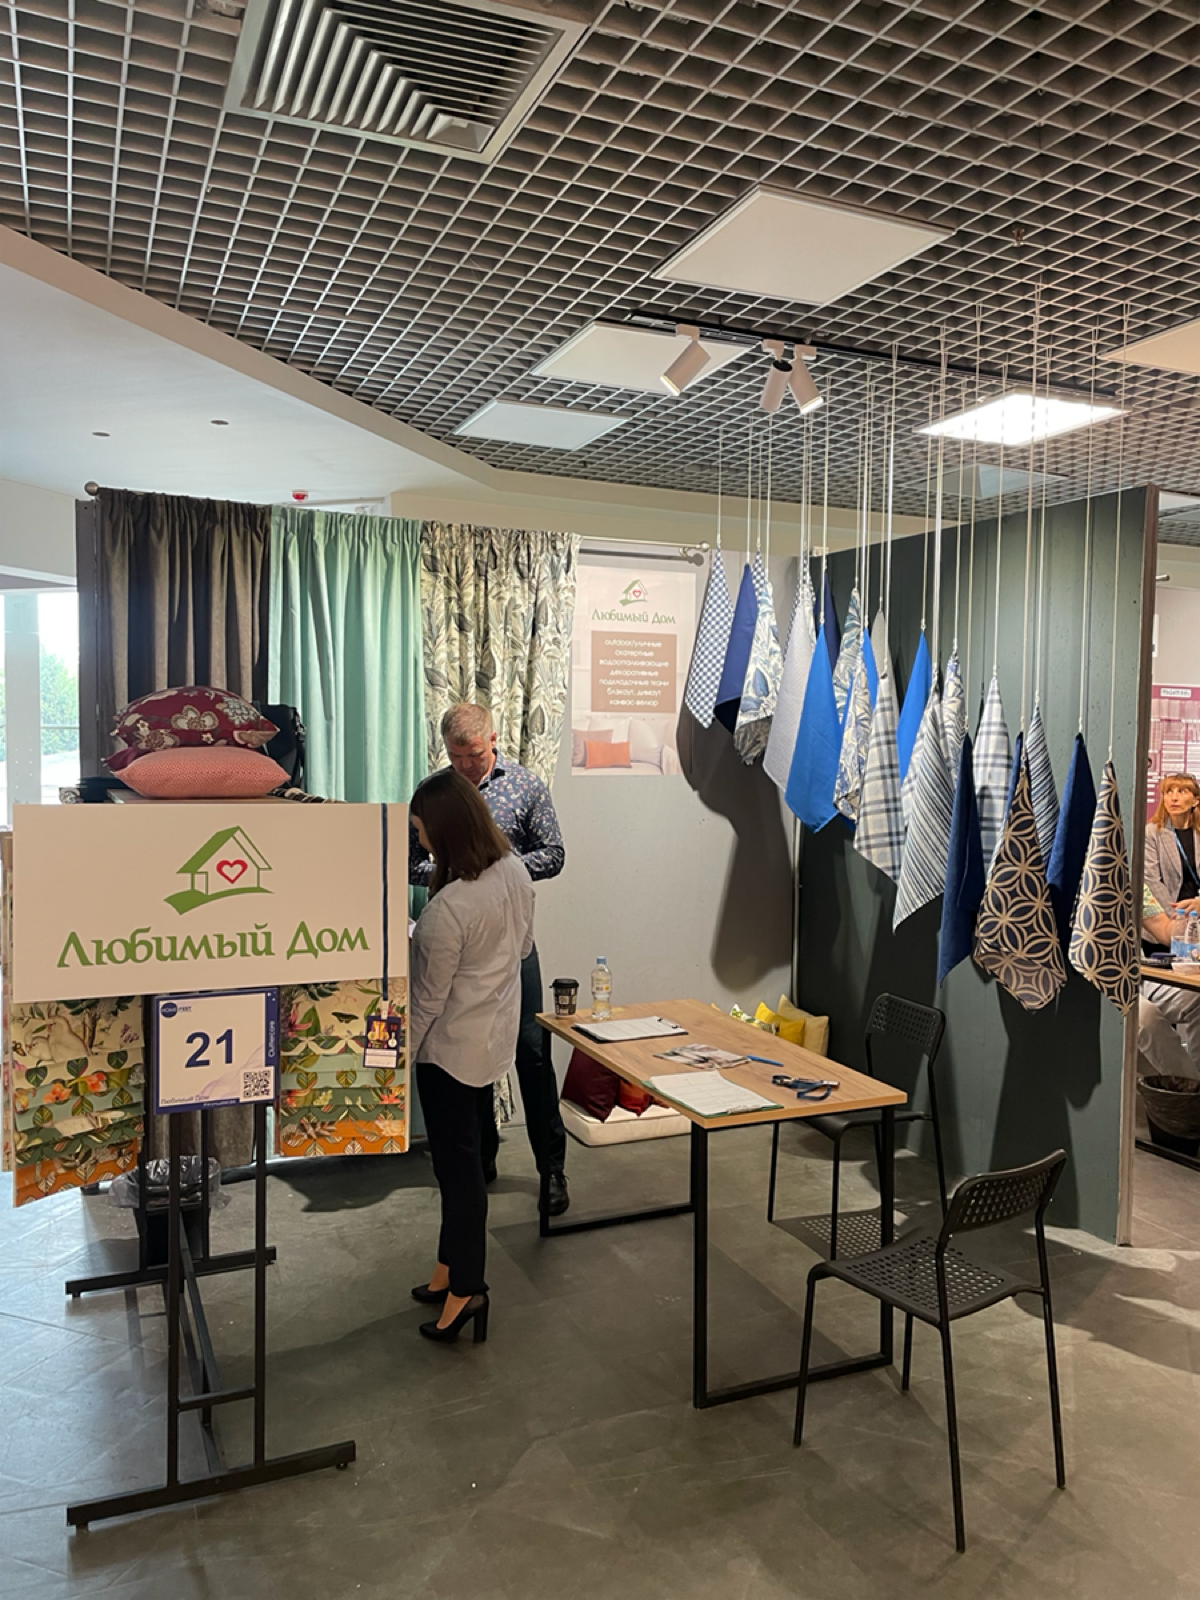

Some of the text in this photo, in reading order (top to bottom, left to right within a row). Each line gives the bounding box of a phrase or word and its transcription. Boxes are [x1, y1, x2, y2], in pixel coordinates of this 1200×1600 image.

[592, 609, 676, 624] Любимый Дом
[57, 920, 370, 968] Любимый Дом
[184, 1028, 234, 1069] 21
